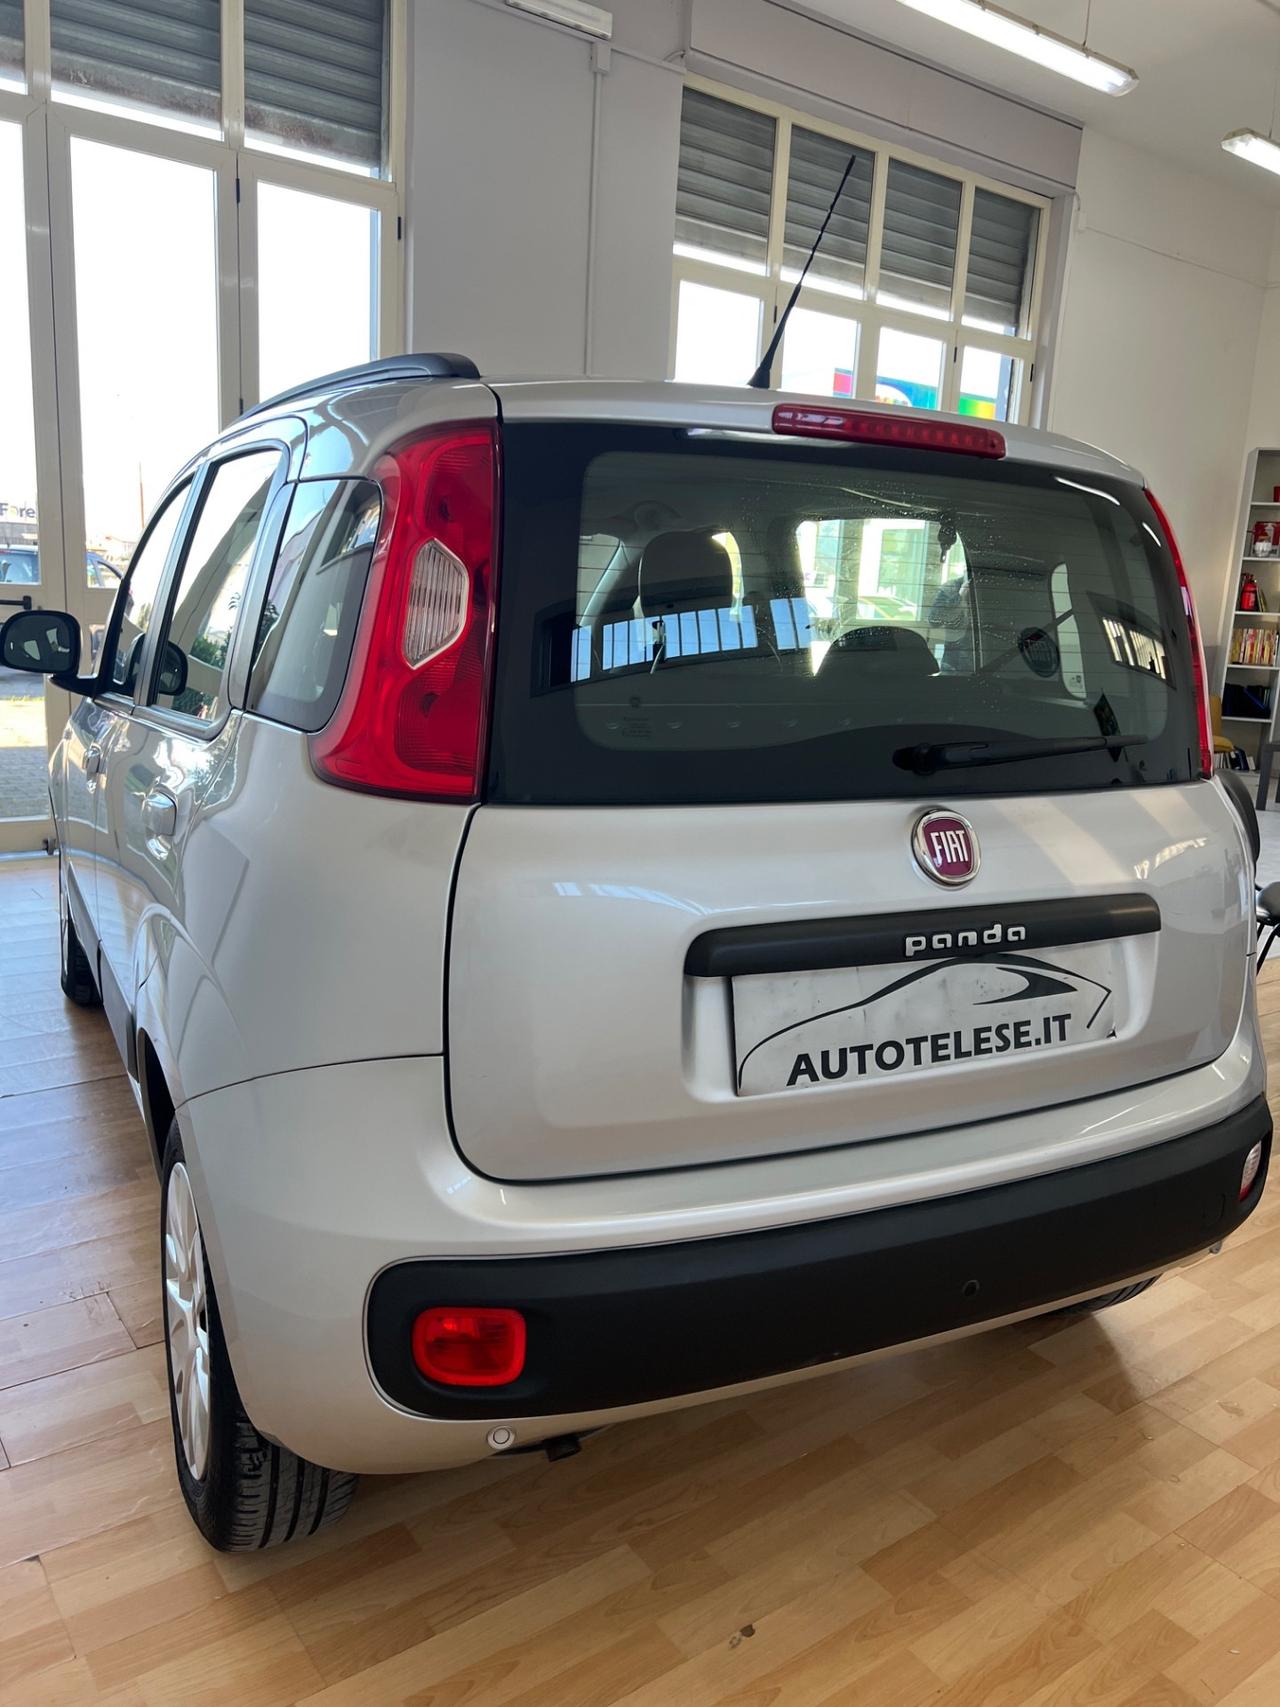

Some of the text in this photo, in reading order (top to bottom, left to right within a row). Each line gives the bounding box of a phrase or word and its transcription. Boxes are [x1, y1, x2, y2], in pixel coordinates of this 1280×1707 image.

[931, 830, 968, 867] FIAT
[905, 924, 1027, 957] panda
[787, 1014, 1073, 1086] AUTOTELESE.IT
